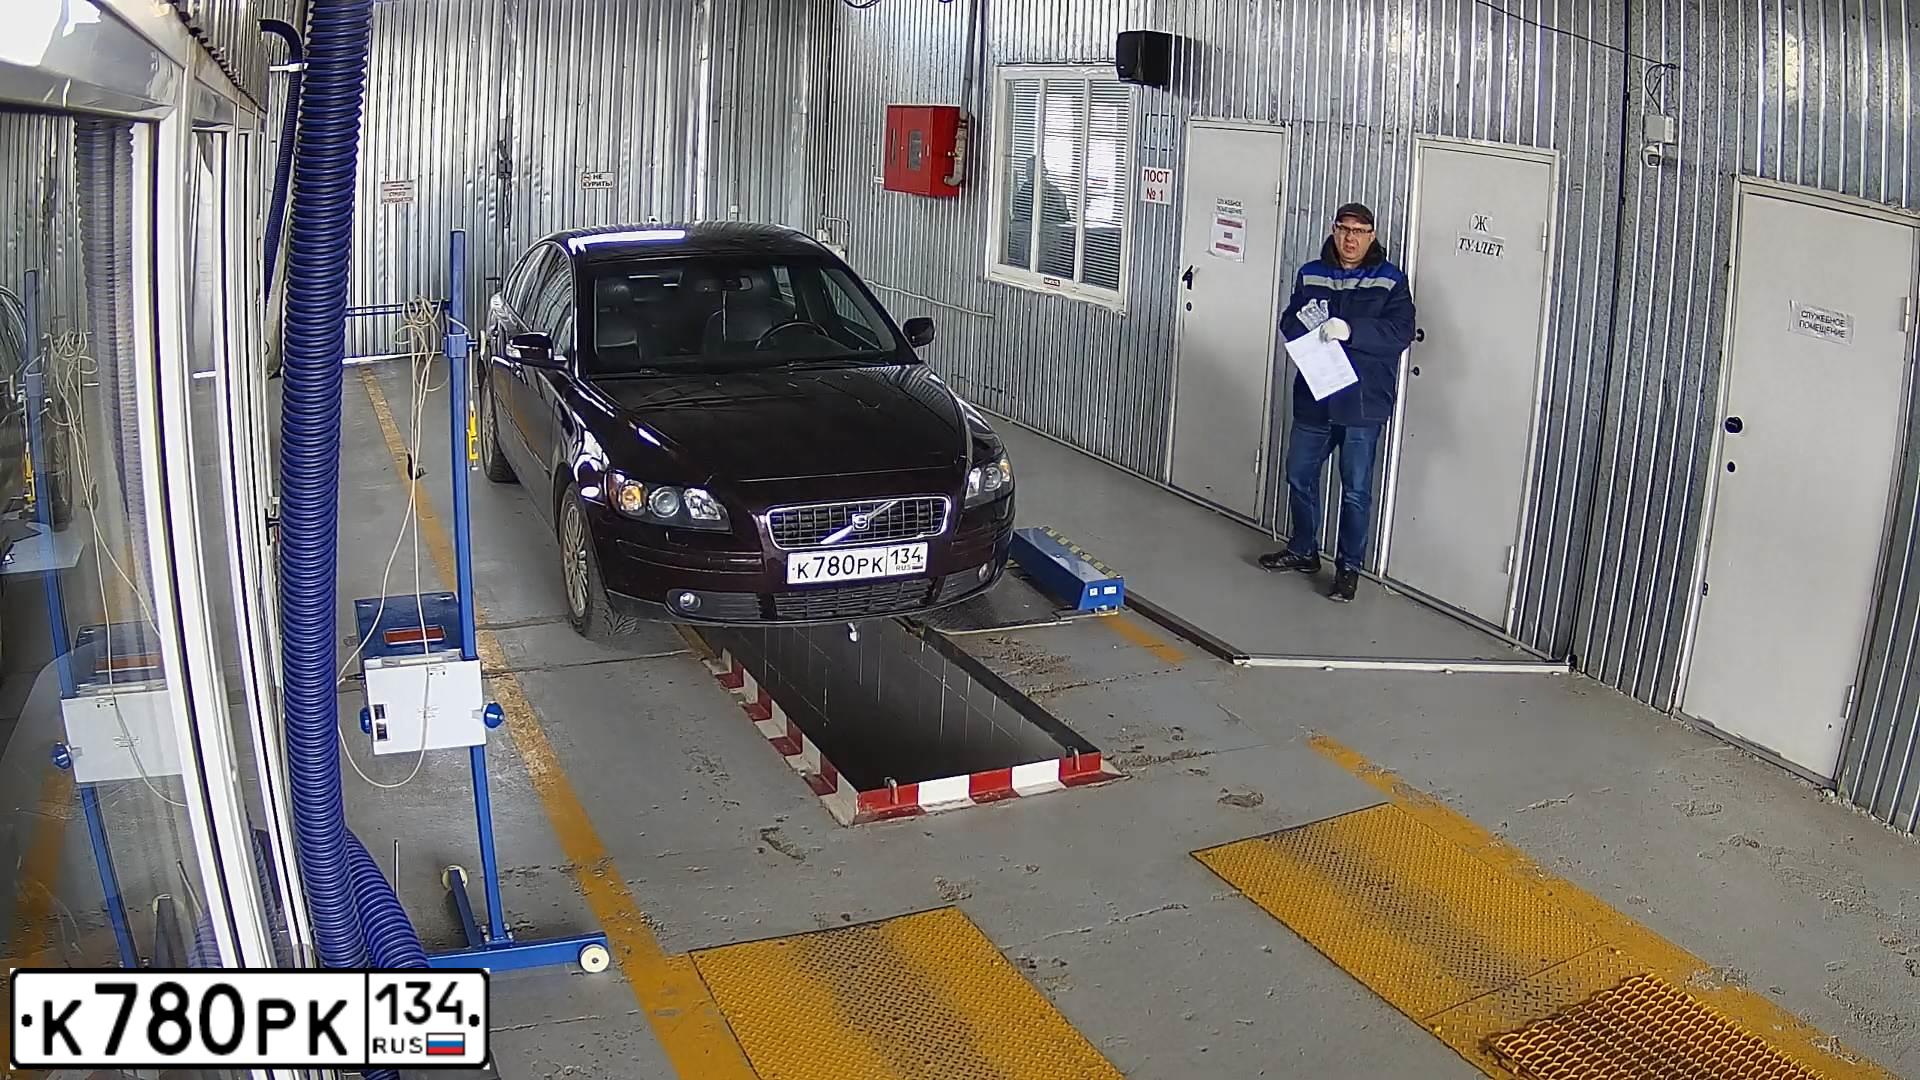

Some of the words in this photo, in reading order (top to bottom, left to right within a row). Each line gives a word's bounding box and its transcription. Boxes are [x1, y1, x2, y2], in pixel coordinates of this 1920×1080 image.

[1144, 169, 1170, 183] ПОСТ
[1146, 188, 1156, 200] №
[1159, 190, 1164, 201] 1
[1474, 215, 1487, 232] Ж
[1459, 238, 1504, 256] ТУАЛЕТ
[1801, 310, 1846, 328] СЛУЖЕБНОЕ
[1799, 320, 1846, 338] ПОМЕЩЕНИЕ
[797, 554, 884, 579] К780РК
[890, 546, 921, 564] 134
